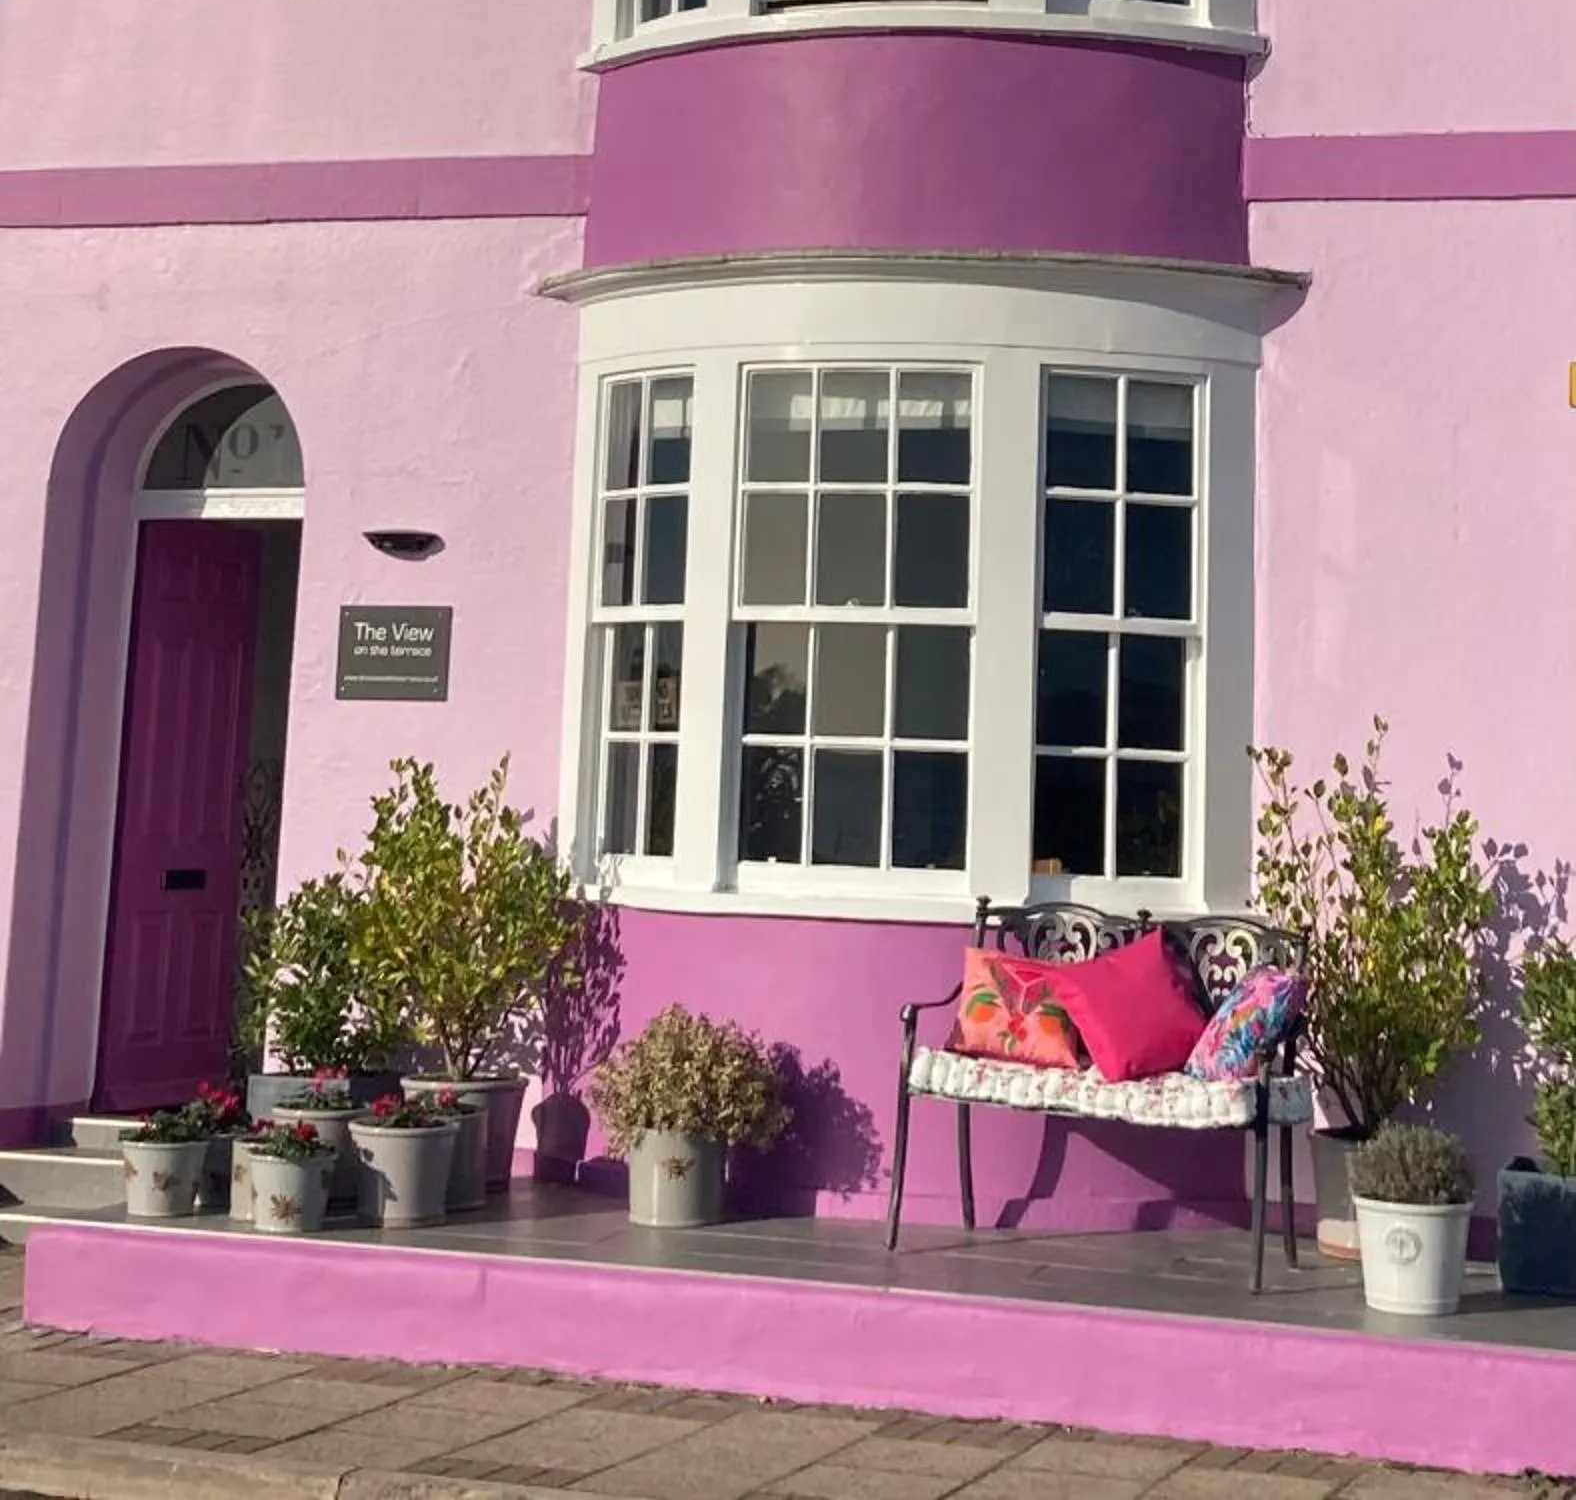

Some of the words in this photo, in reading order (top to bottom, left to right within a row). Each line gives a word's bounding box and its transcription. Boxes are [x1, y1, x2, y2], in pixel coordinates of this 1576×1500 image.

[353, 621, 387, 641] The
[391, 621, 435, 641] View
[353, 646, 369, 656] on
[369, 645, 388, 656] the
[390, 645, 432, 657] terrace
